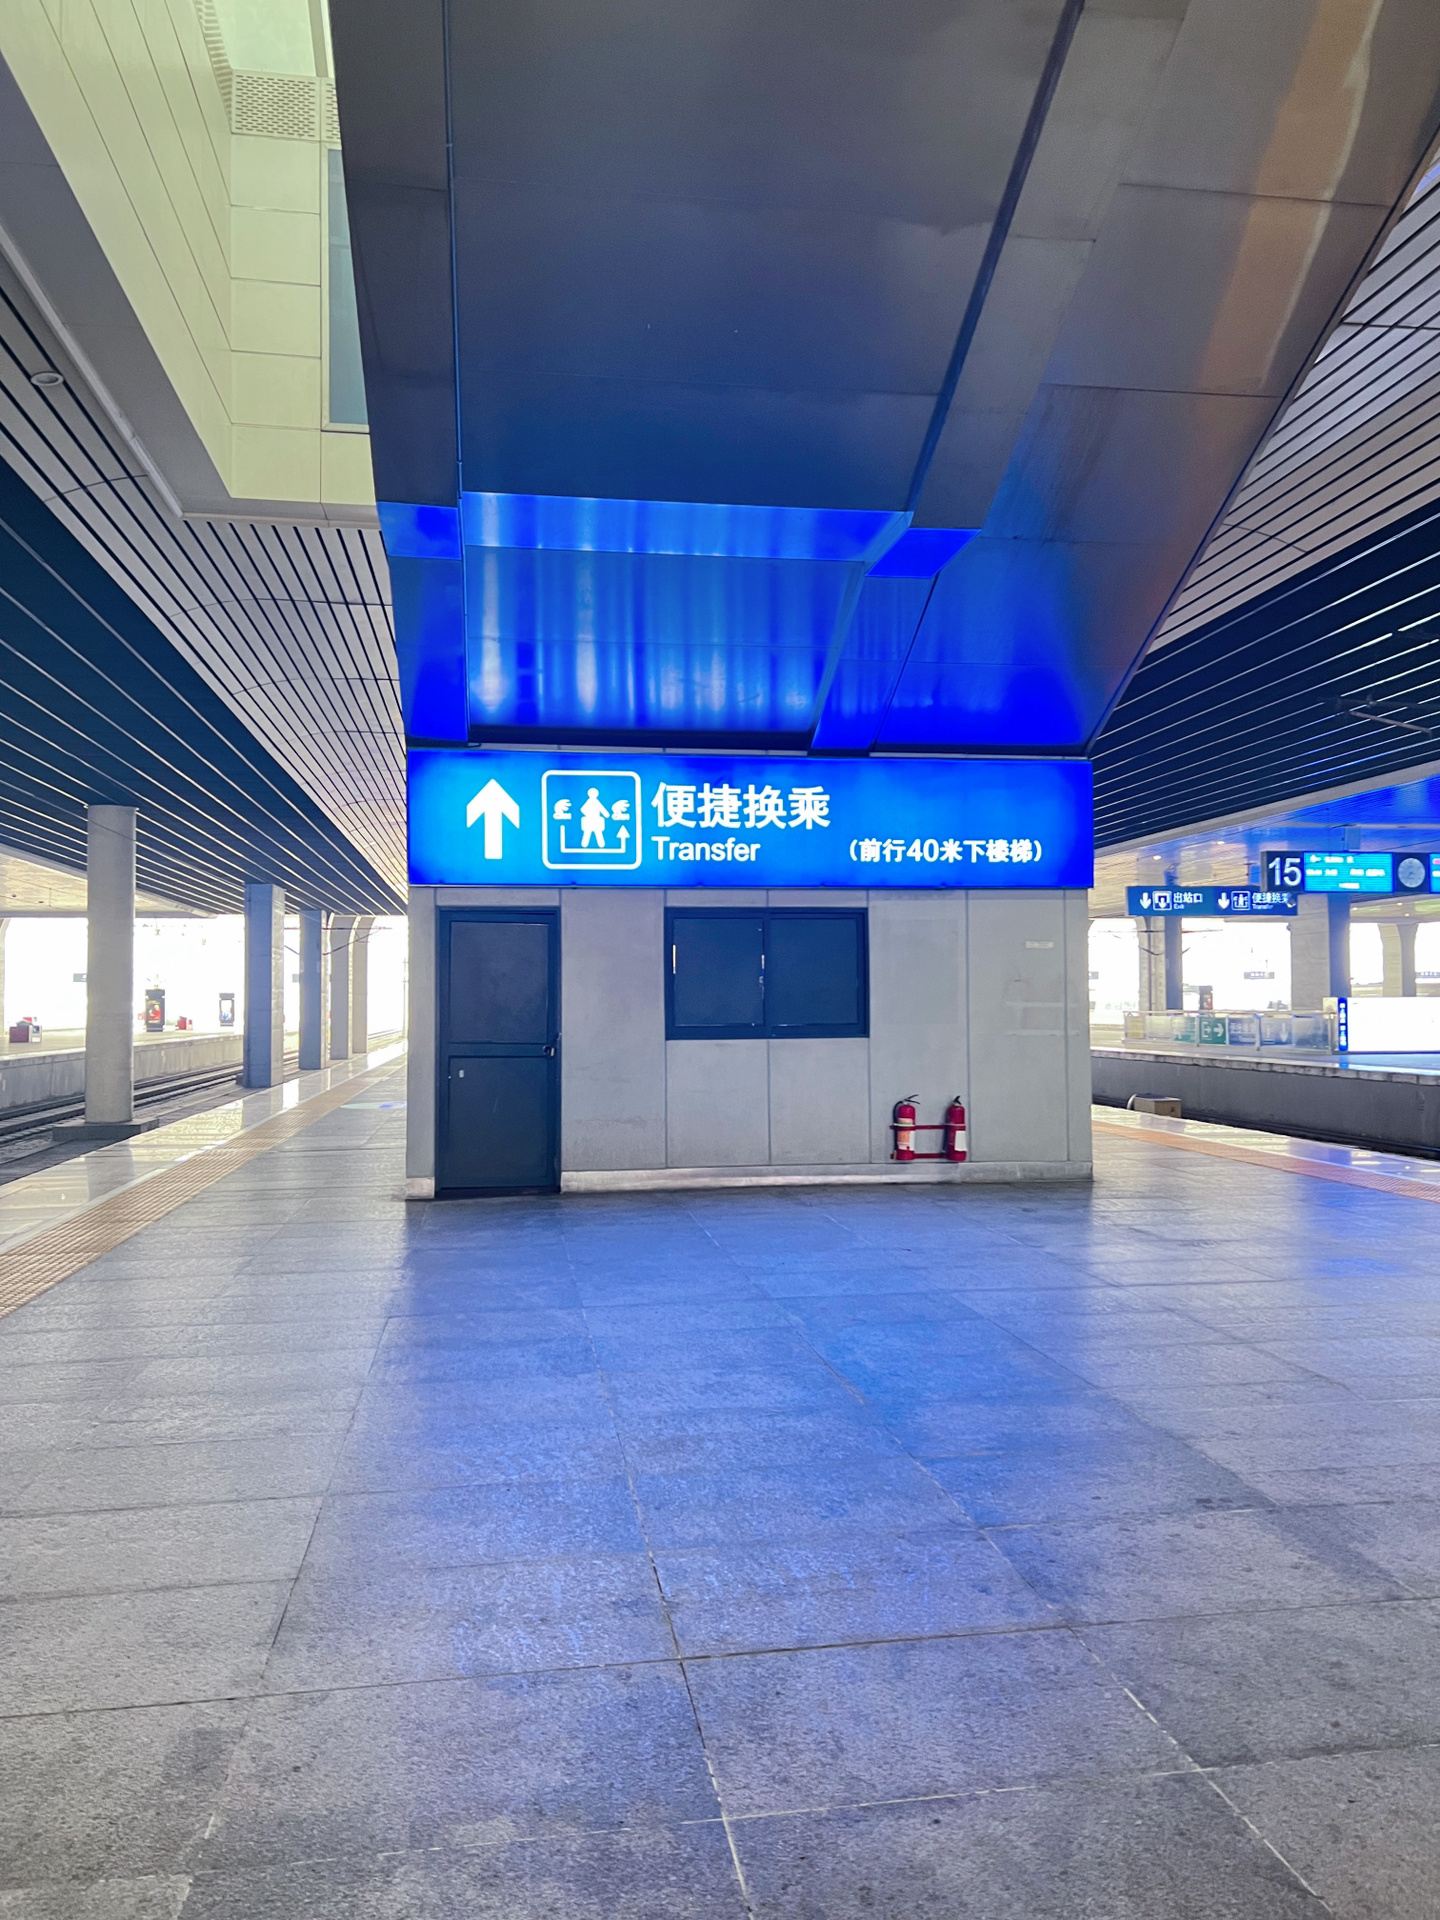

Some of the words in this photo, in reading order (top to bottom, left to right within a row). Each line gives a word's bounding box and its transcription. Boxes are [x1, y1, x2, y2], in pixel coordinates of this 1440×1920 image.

[650, 781, 831, 830] 便捷换乘
[651, 836, 761, 862] Transfer
[1268, 856, 1302, 887] 15
[1173, 891, 1203, 904] 出站口
